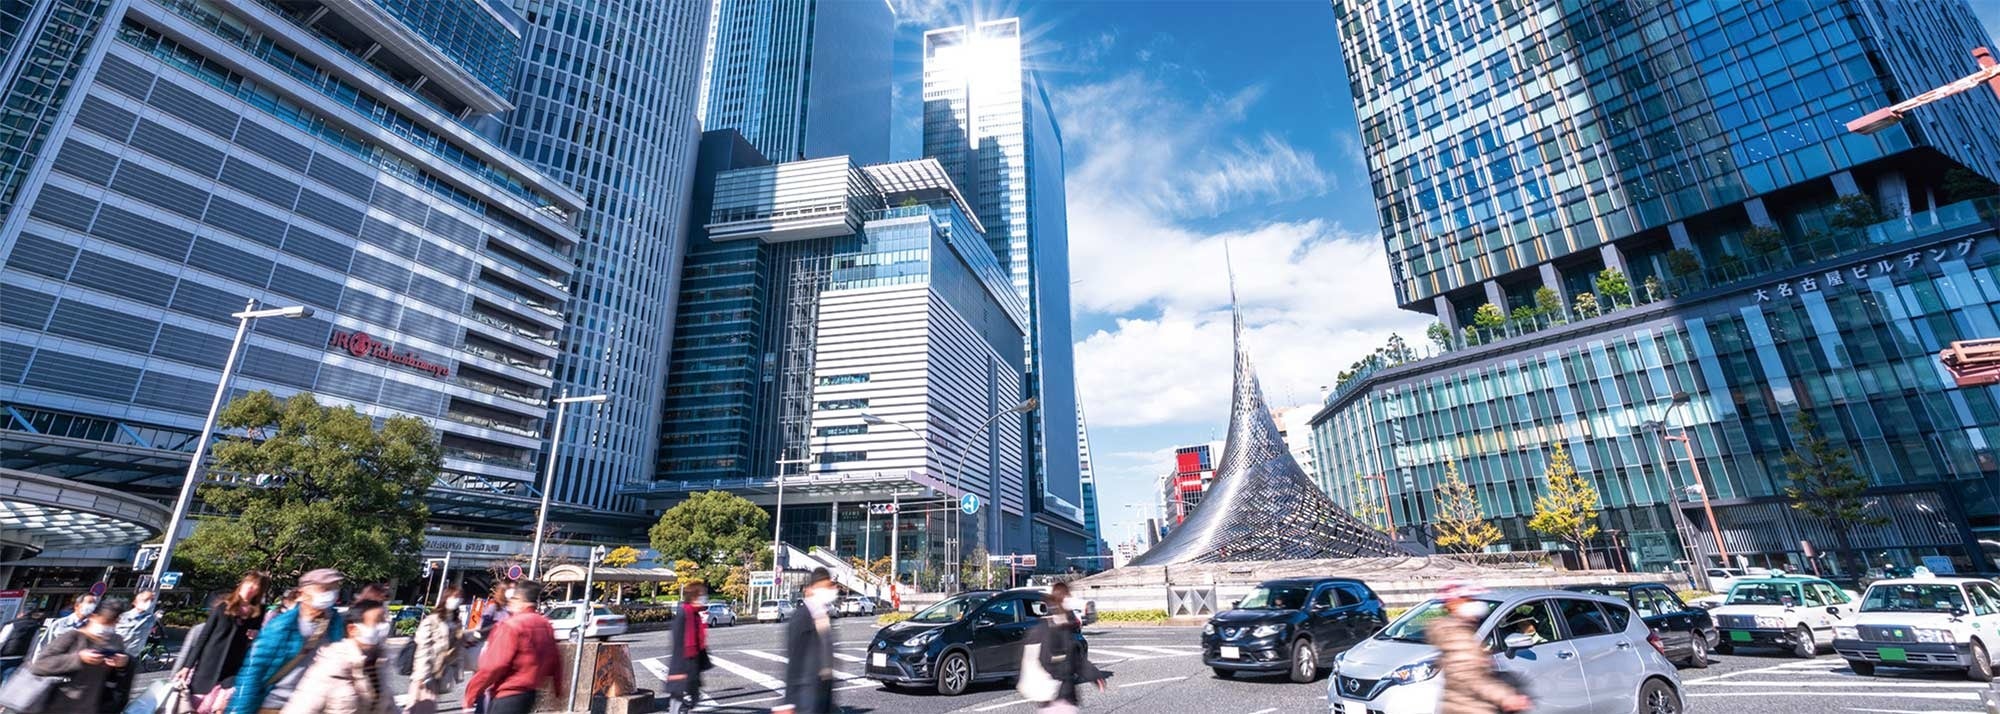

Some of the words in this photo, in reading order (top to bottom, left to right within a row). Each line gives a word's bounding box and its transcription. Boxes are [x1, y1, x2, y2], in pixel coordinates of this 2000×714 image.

[1753, 238, 1975, 302] 大名古屋ビルヂング
[330, 330, 350, 349] JR
[370, 342, 449, 377] Takashimaya
